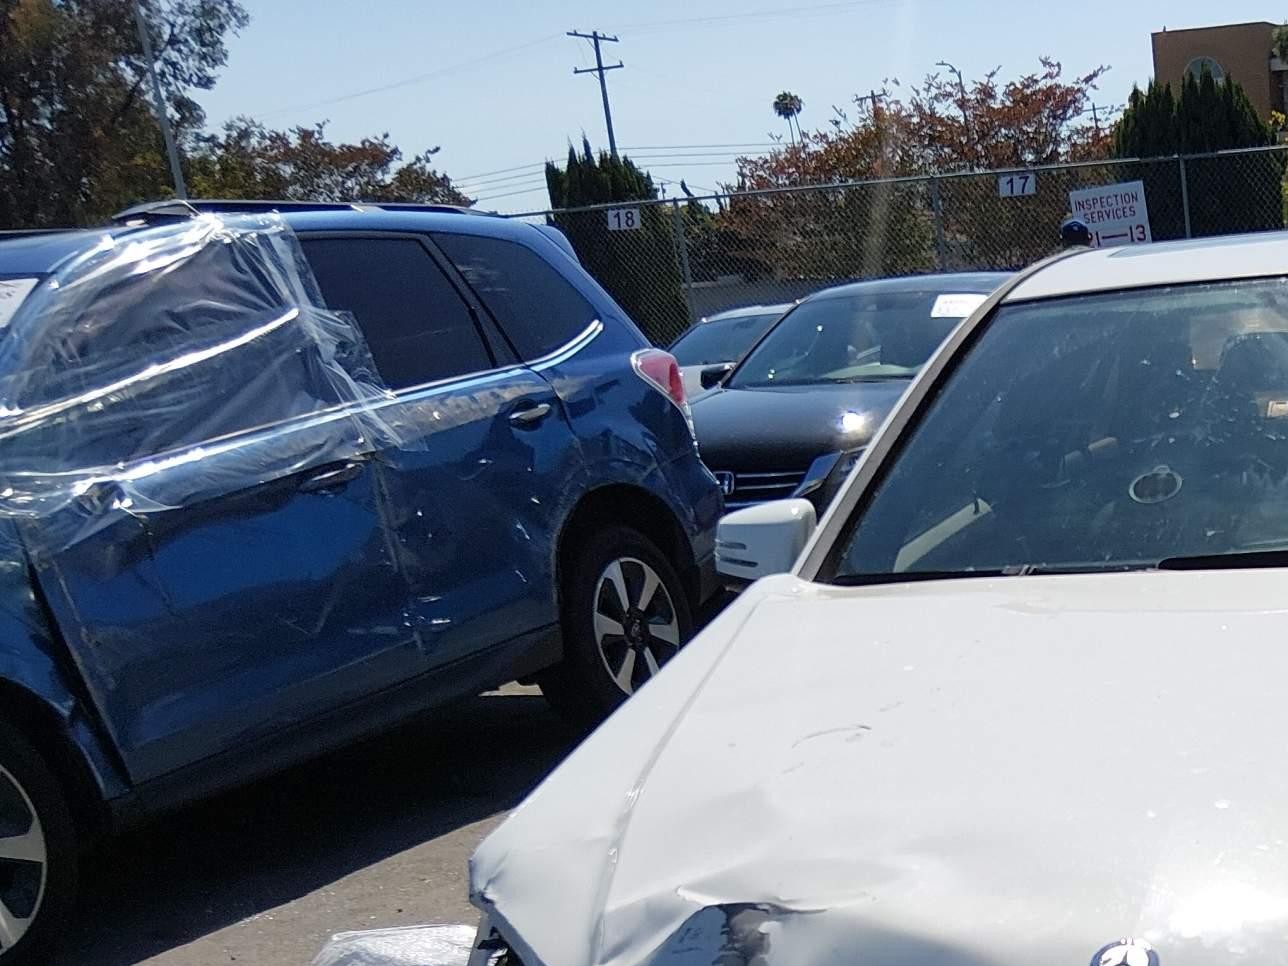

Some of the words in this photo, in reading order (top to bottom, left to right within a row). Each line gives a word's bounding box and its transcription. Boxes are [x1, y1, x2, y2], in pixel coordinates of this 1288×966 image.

[1006, 175, 1030, 195] 17
[1074, 191, 1138, 212] INSPECTION
[613, 211, 635, 228] 18
[1083, 206, 1136, 224] SERVICES
